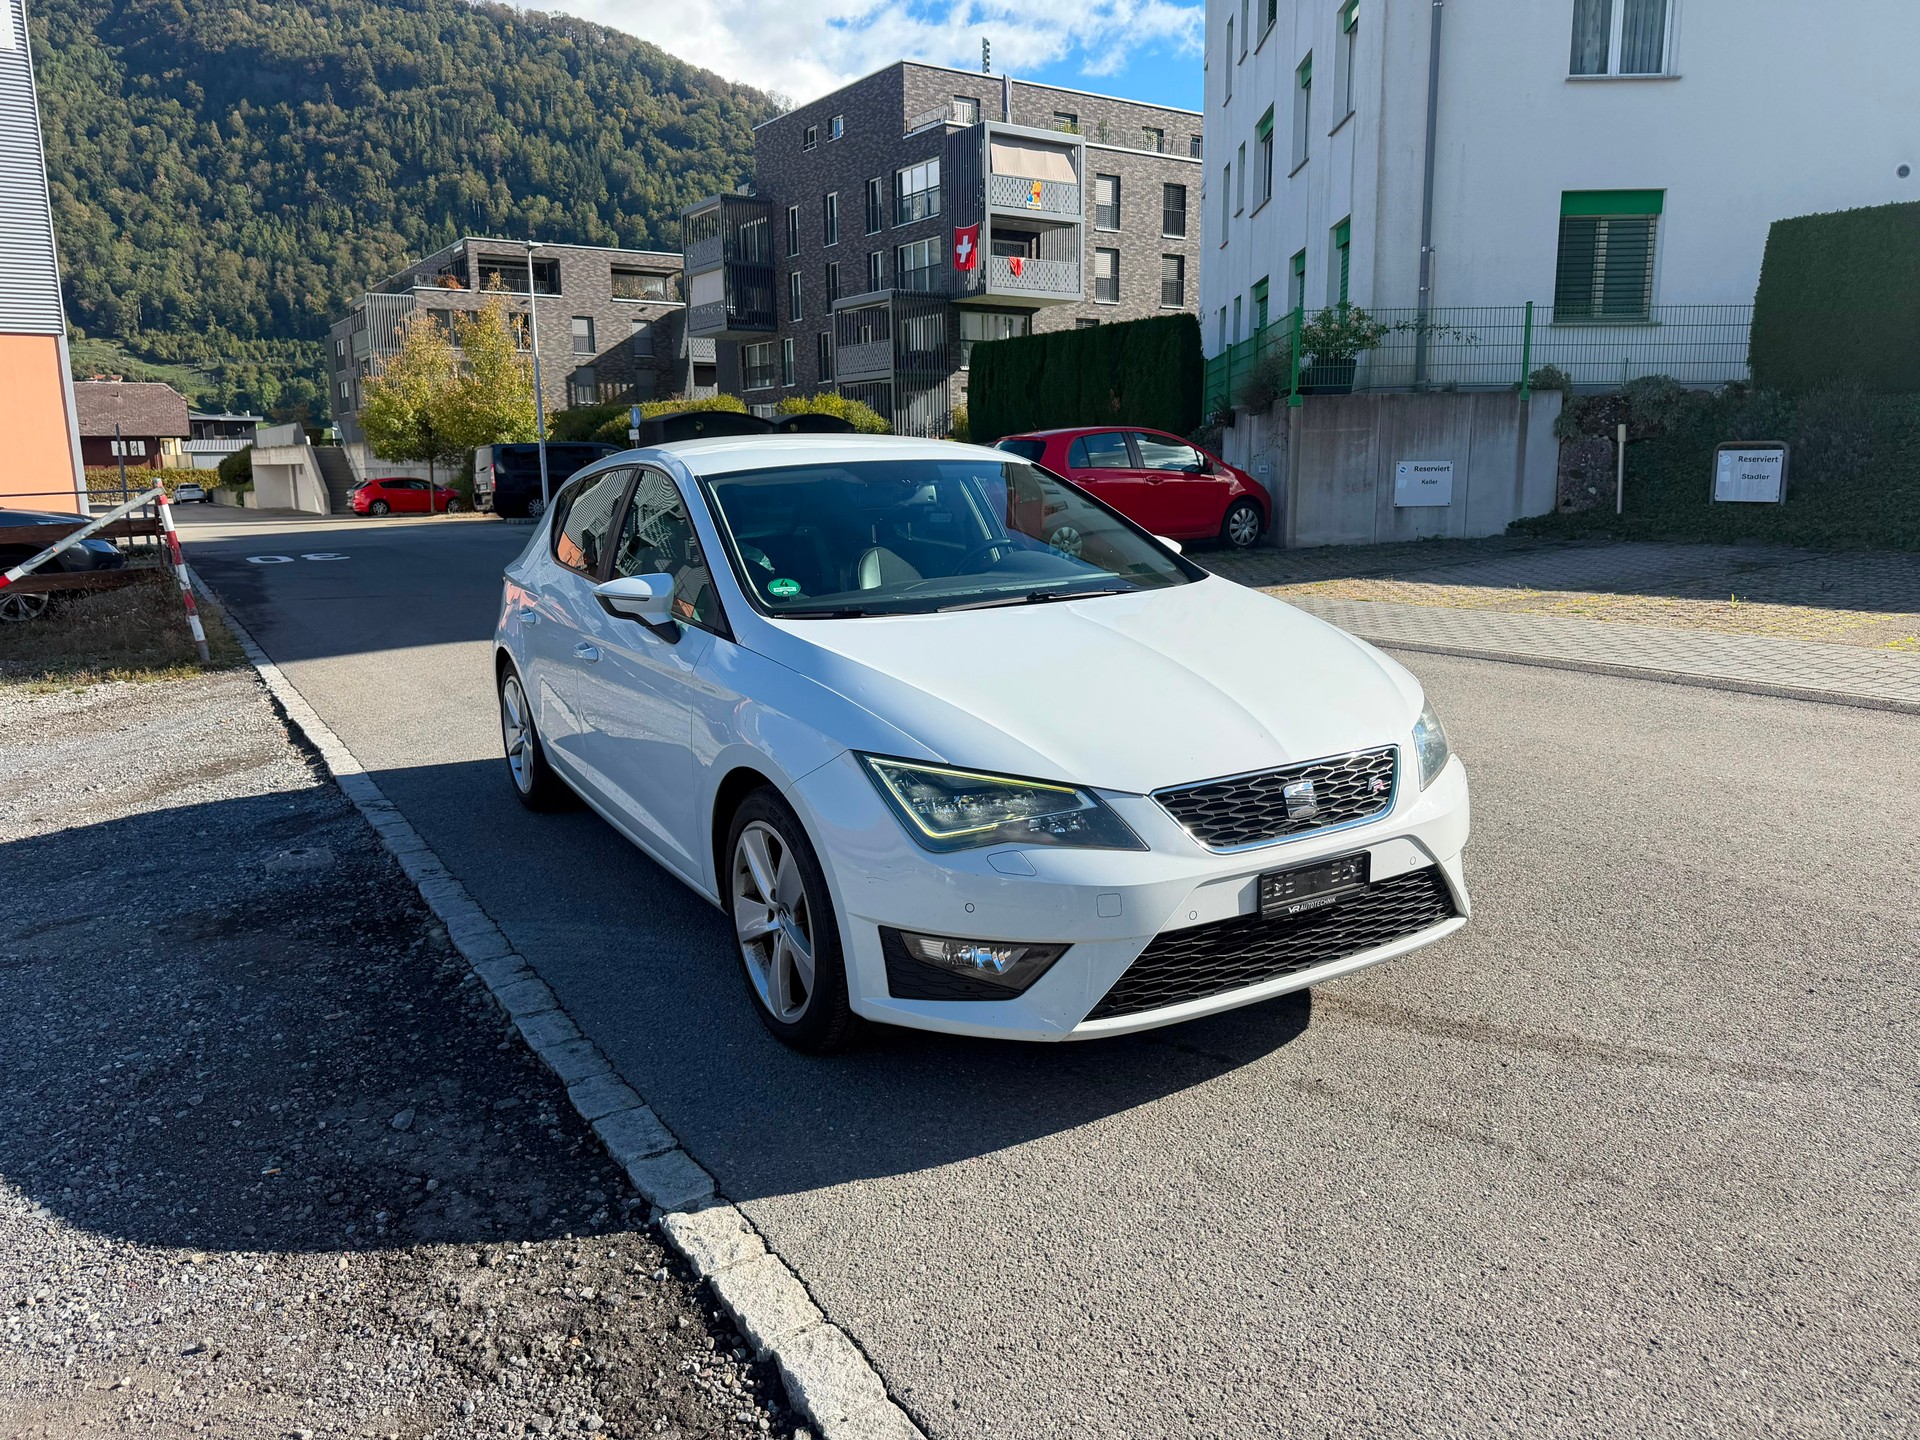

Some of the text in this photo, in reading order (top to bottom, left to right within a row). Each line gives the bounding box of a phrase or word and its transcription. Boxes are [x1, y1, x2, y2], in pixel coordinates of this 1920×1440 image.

[1738, 455, 1779, 463] Reserviert
[780, 579, 788, 587] 4
[1367, 778, 1385, 792] FR
